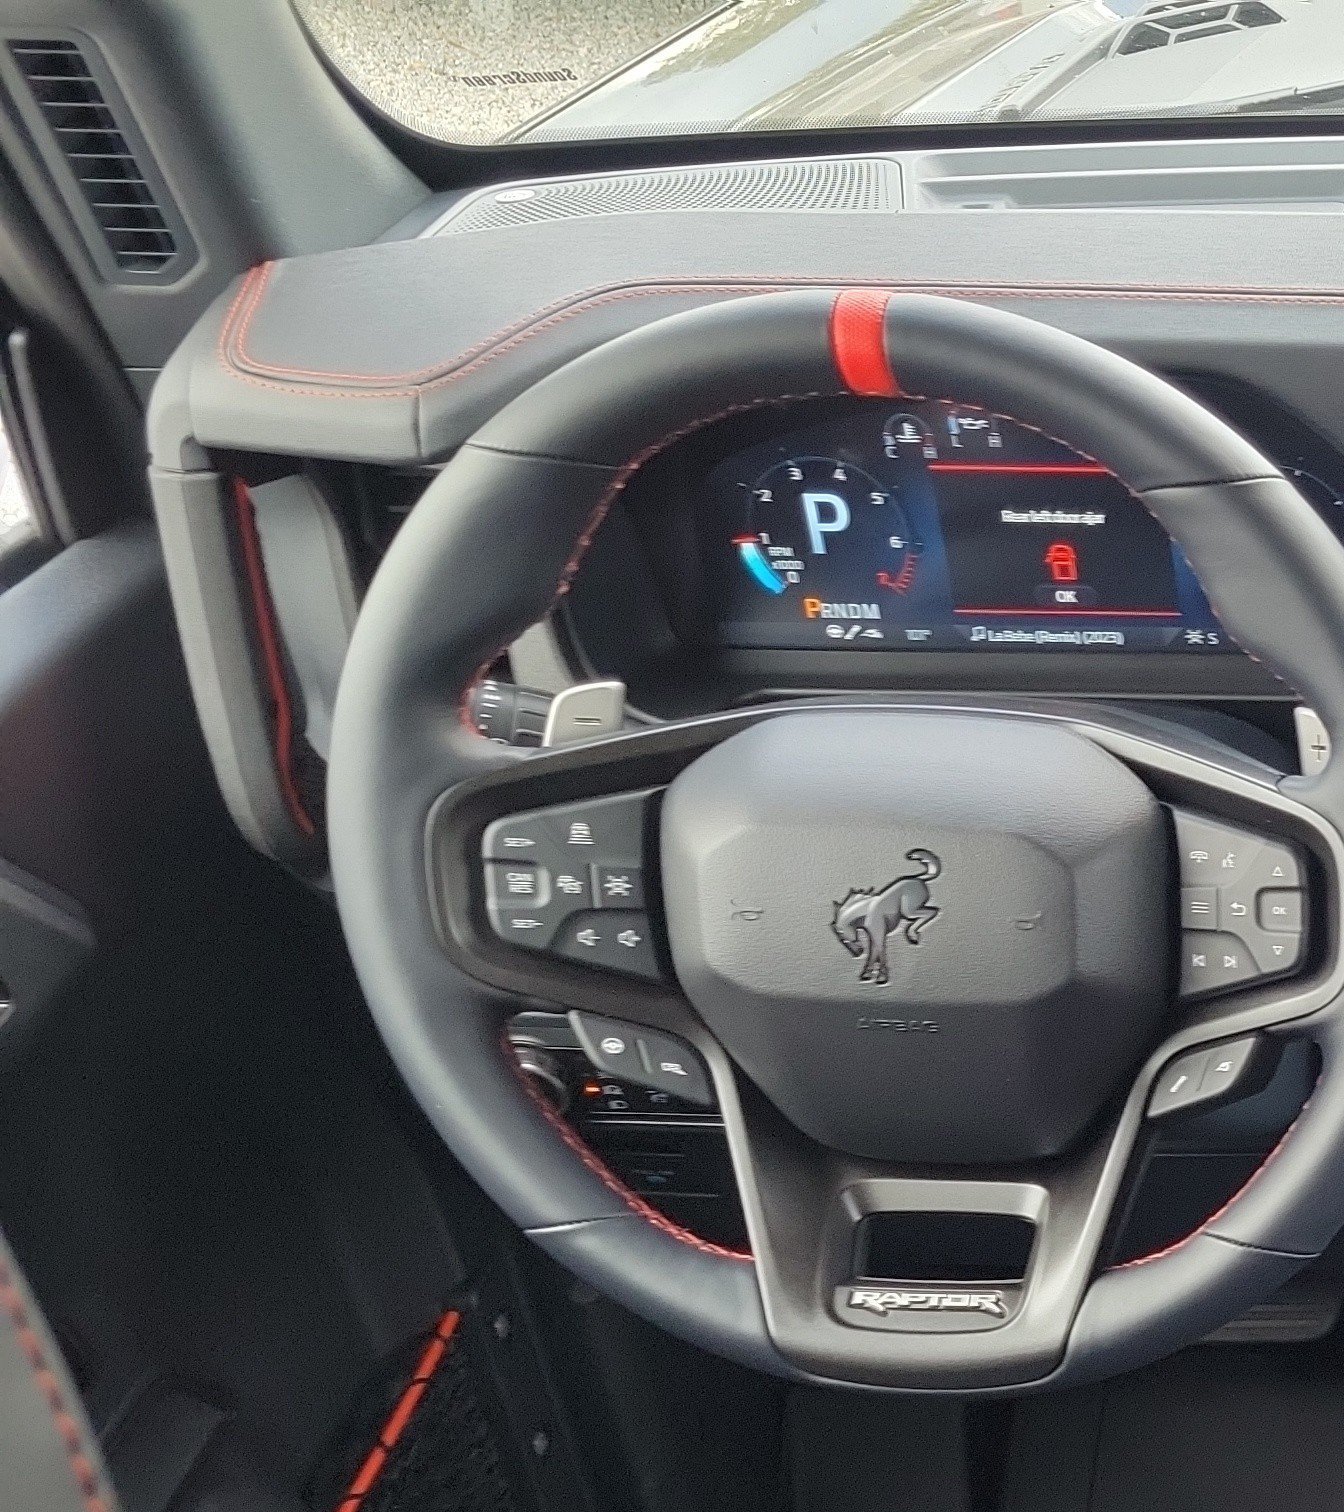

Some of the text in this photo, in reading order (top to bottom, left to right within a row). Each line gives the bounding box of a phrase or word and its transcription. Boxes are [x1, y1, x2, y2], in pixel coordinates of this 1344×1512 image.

[788, 467, 803, 480] 3
[760, 489, 774, 501] 2
[802, 492, 850, 554] P
[1055, 591, 1078, 603] OK
[1272, 906, 1287, 915] OK
[848, 1290, 1006, 1318] RAPTOR
